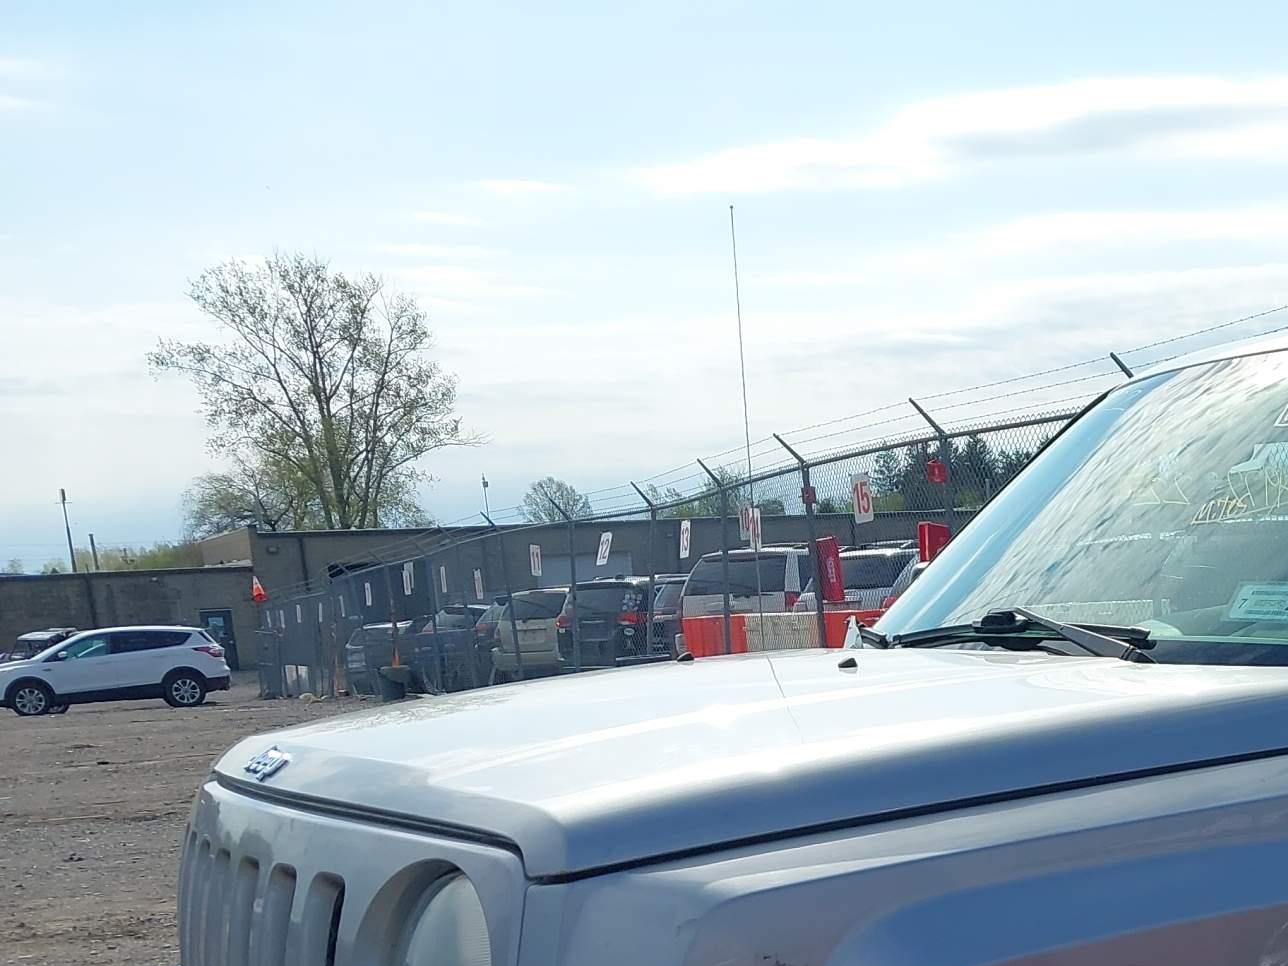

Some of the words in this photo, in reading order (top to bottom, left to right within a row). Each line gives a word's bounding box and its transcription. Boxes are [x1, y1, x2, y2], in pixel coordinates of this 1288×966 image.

[852, 480, 872, 515] 15
[598, 538, 610, 561] 12
[681, 527, 690, 553] 13
[531, 551, 541, 572] 11
